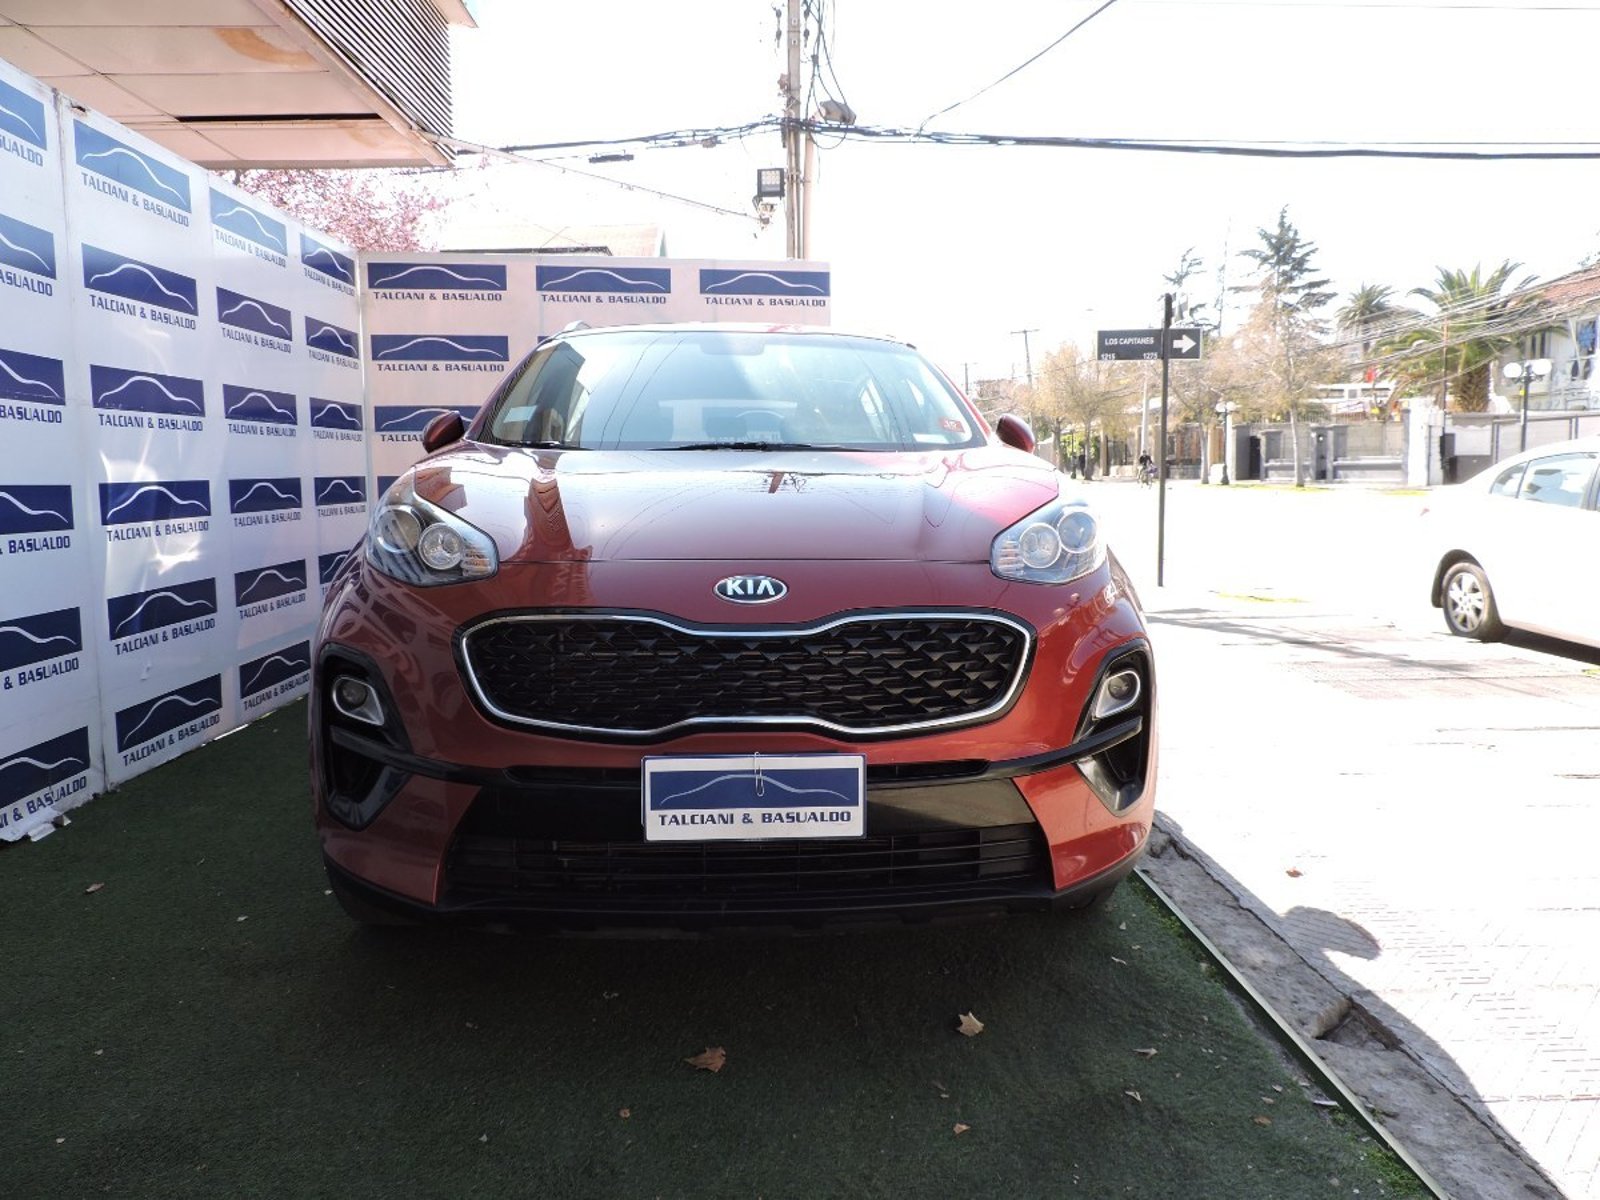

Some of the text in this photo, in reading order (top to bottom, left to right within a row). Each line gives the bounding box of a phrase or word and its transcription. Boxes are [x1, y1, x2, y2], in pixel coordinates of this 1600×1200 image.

[81, 172, 189, 227] TALCIANI & BASUALDO
[373, 291, 503, 302] TALCIANI & BASUALDO
[541, 294, 667, 305] TALCIANI & BASUALDO
[705, 297, 827, 308] TALCIANI & BASUALDO
[90, 294, 196, 330] TALCIANI & BASUALDO
[221, 327, 291, 353] TALCIANI & BASUALDO
[1119, 337, 1154, 345] CAPITANES
[377, 362, 505, 373] TALCIANI & BASUALDO
[0, 404, 62, 423] BASUALDO
[98, 413, 203, 432] TALCIANI & BASUALDO
[228, 423, 296, 438] TALCIANI & BASUALDO
[107, 521, 209, 542] TALCIANI & BASUALDO
[8, 535, 71, 554] BASUALDO
[726, 578, 776, 596] KIA
[115, 618, 216, 656] TALCIANI & BASUALDO
[4, 657, 80, 690] & BASUALDO
[122, 714, 220, 767] TALCIANI & BASUALDO
[13, 807, 24, 822] &
[26, 776, 87, 814] BASUALDO
[658, 811, 851, 827] TALCIANI & BASUALDO
